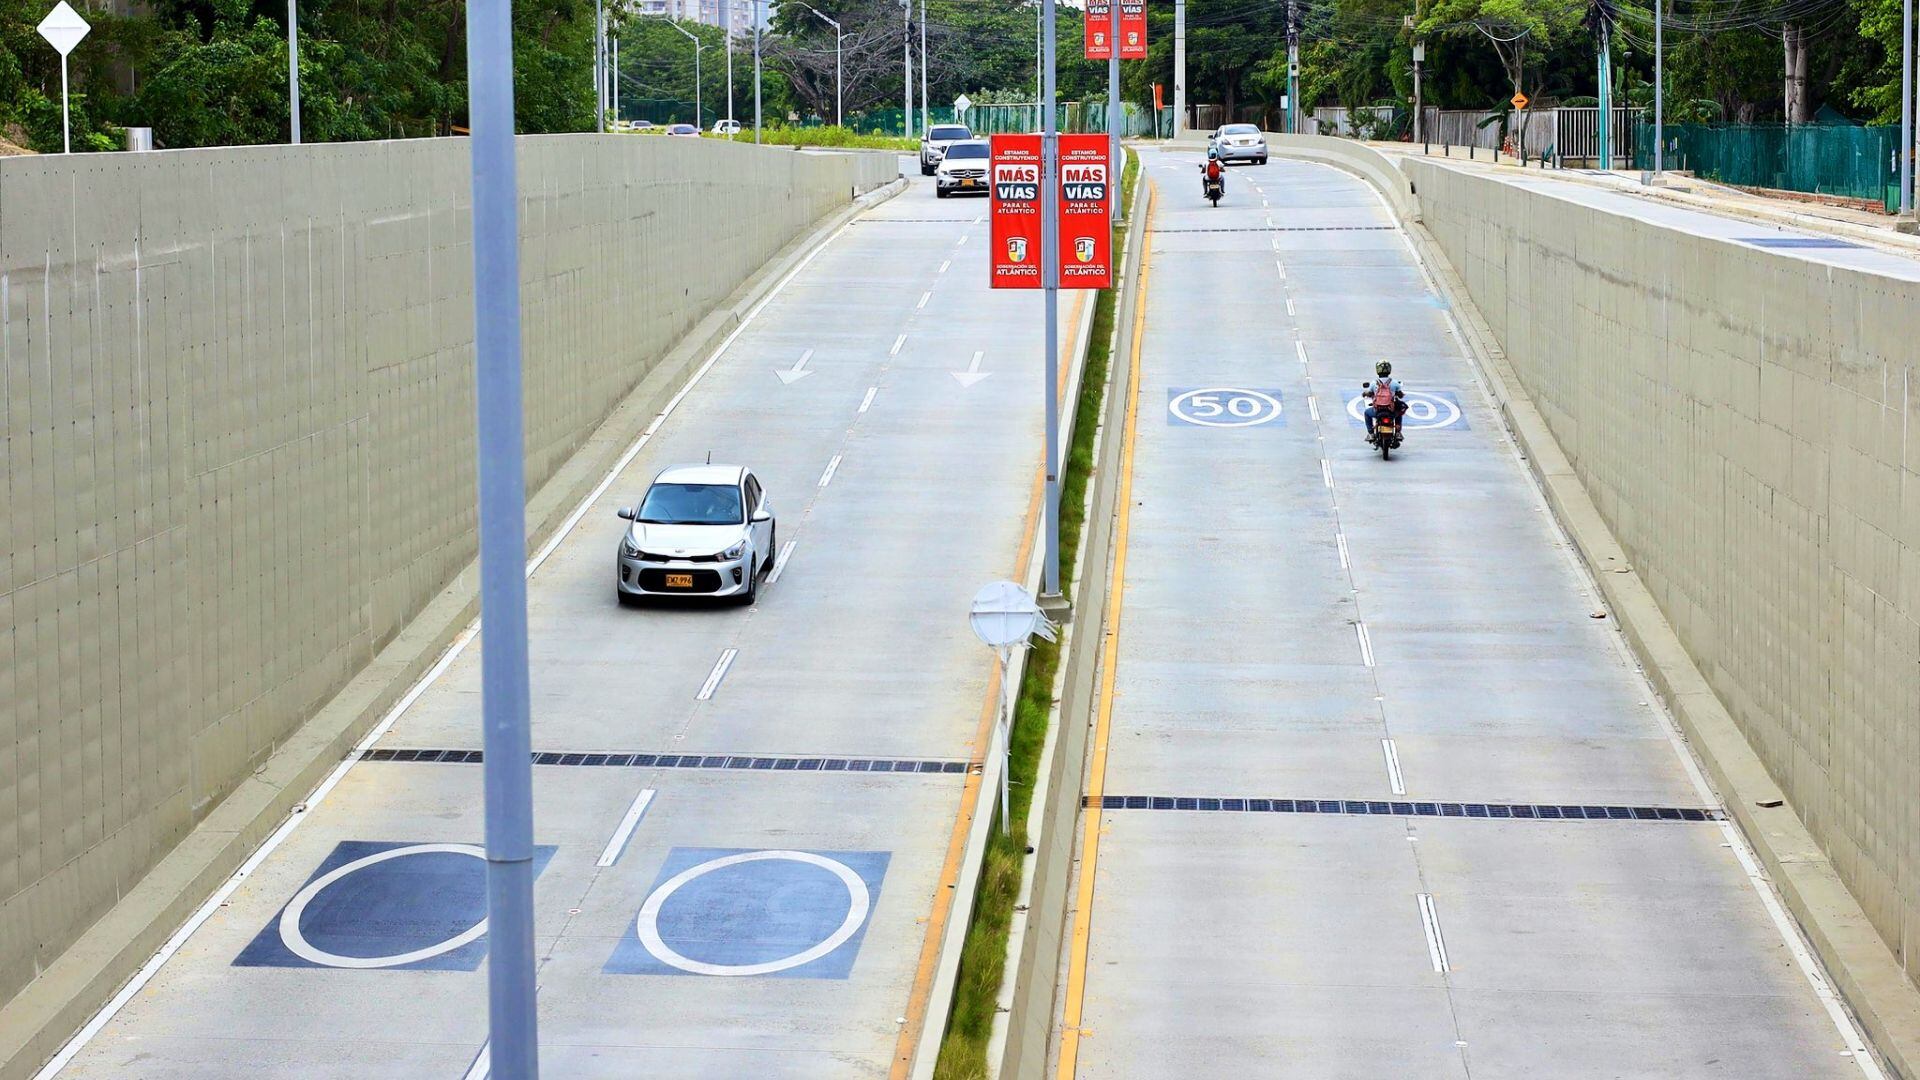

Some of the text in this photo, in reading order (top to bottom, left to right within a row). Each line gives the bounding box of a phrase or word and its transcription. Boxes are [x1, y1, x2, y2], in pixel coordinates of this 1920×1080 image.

[999, 167, 1035, 181] MÁS
[1066, 167, 1103, 181] MÁS
[998, 185, 1035, 199] VÍAS
[1065, 185, 1103, 199] VÍAS
[996, 268, 1037, 276] ATLÁNTICO
[1064, 268, 1105, 276] ATLÁNTICO
[1190, 396, 1262, 417] 50
